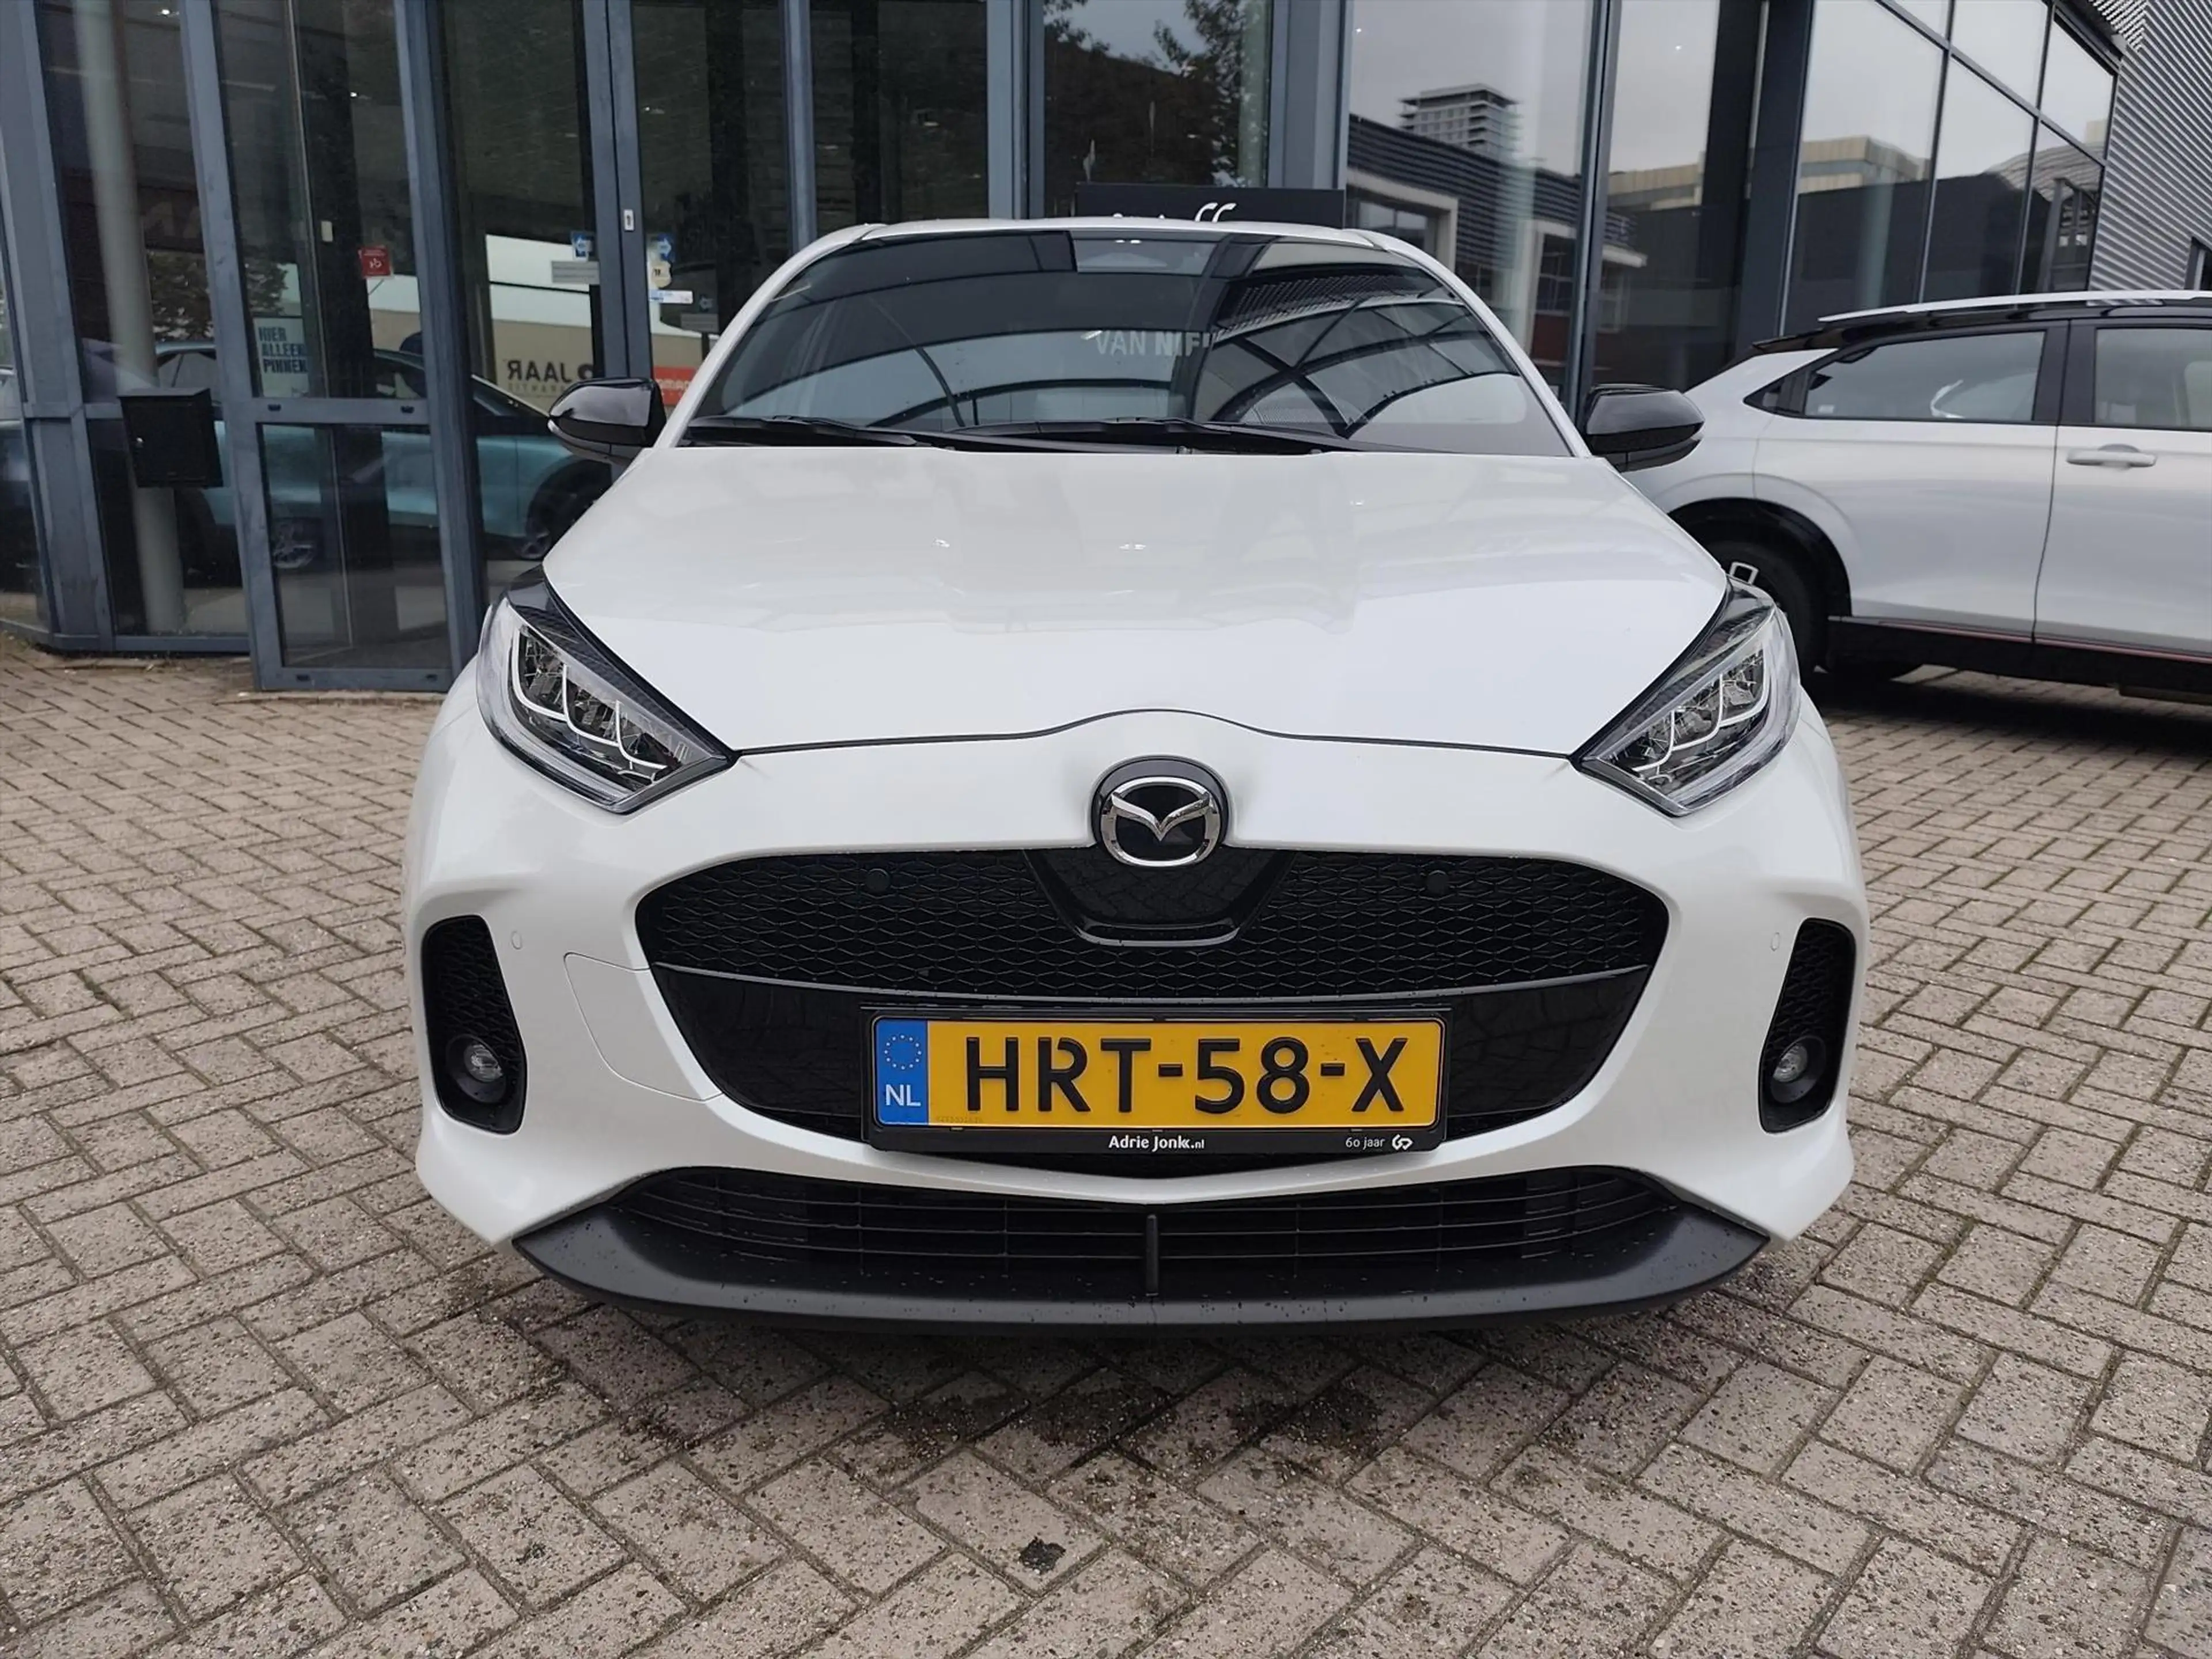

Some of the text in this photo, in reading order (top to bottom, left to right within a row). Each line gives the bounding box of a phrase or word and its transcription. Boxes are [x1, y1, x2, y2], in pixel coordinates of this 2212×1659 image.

[258, 326, 286, 342] HIER
[262, 343, 308, 357] ALLEEN
[1096, 330, 1146, 356] VAN
[263, 358, 309, 373] PINNEN
[966, 1036, 1408, 1114] HRT-58-X
[885, 1084, 921, 1107] NL
[1108, 1134, 1150, 1149] Adrie
[1362, 1137, 1385, 1150] jaar
